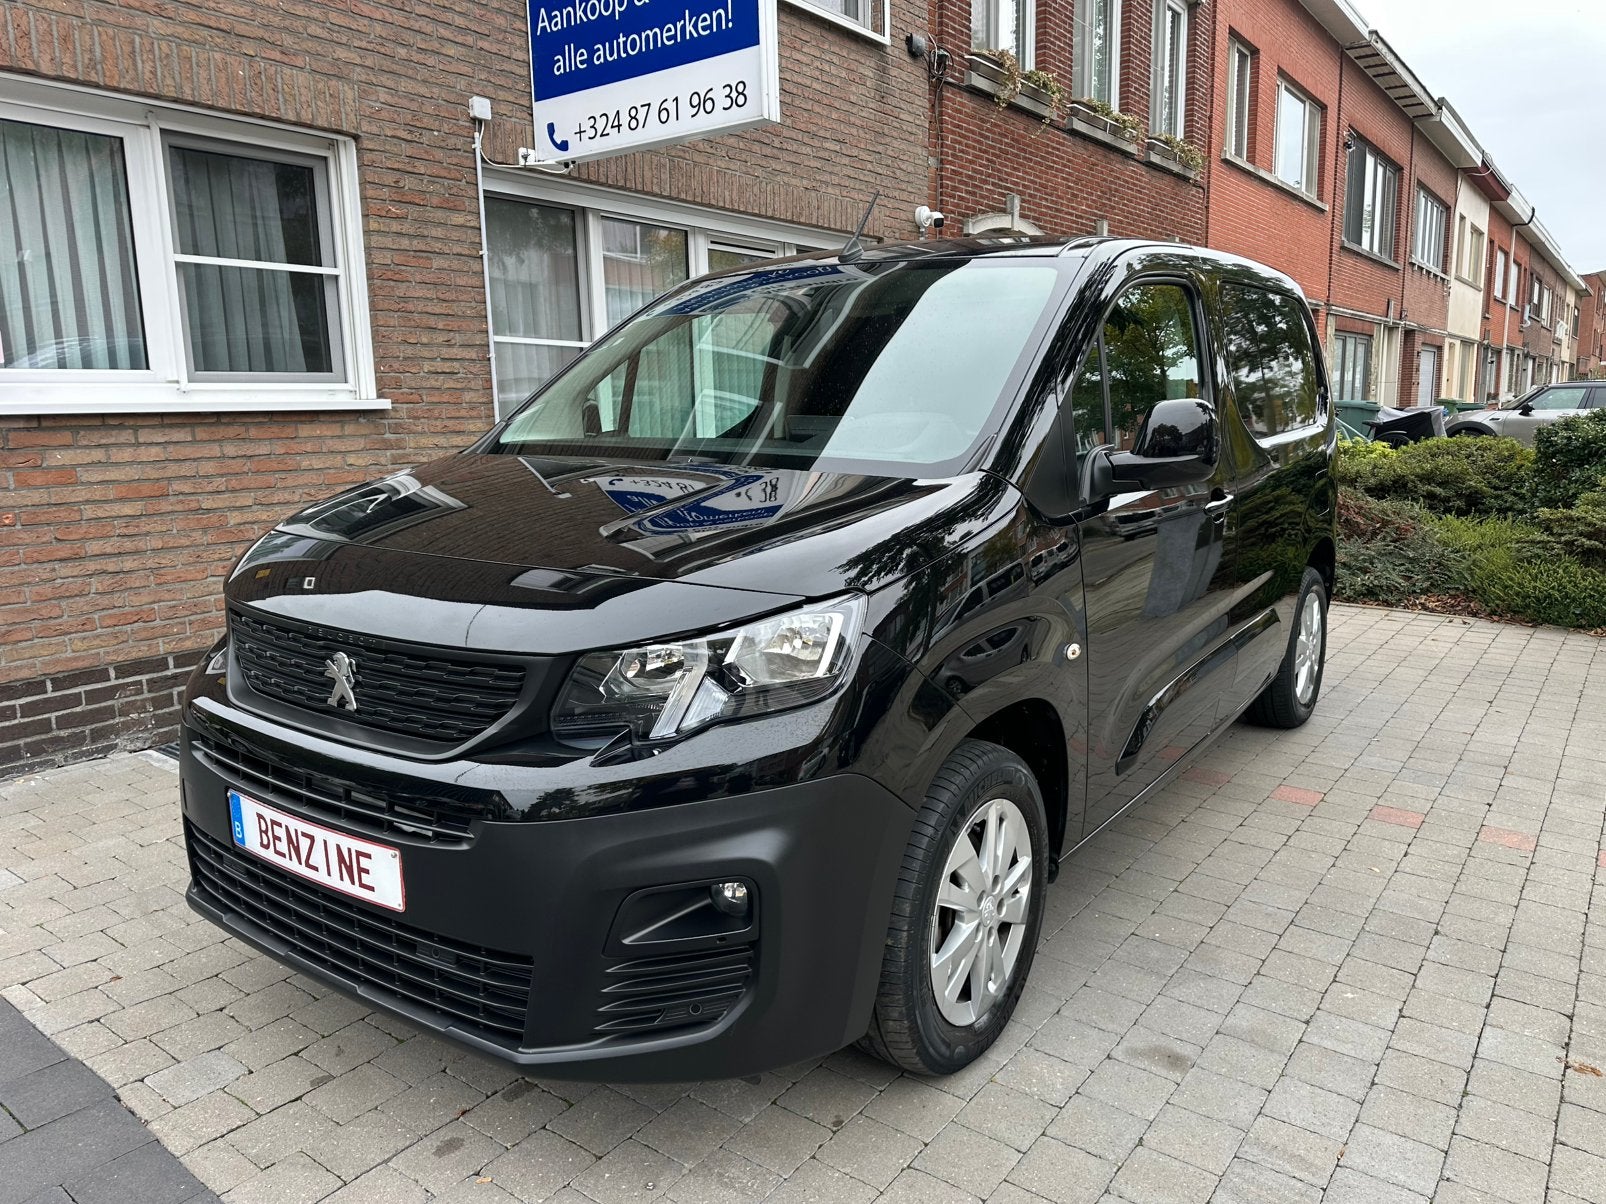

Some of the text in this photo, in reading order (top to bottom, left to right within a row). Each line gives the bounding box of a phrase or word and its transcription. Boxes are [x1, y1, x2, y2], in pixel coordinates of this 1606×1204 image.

[537, 0, 627, 36] Aankoop
[553, 0, 733, 76] alle automerken!
[574, 80, 748, 142] +324 87 61 96 38
[234, 821, 243, 838] B
[255, 812, 376, 893] BENZINE
